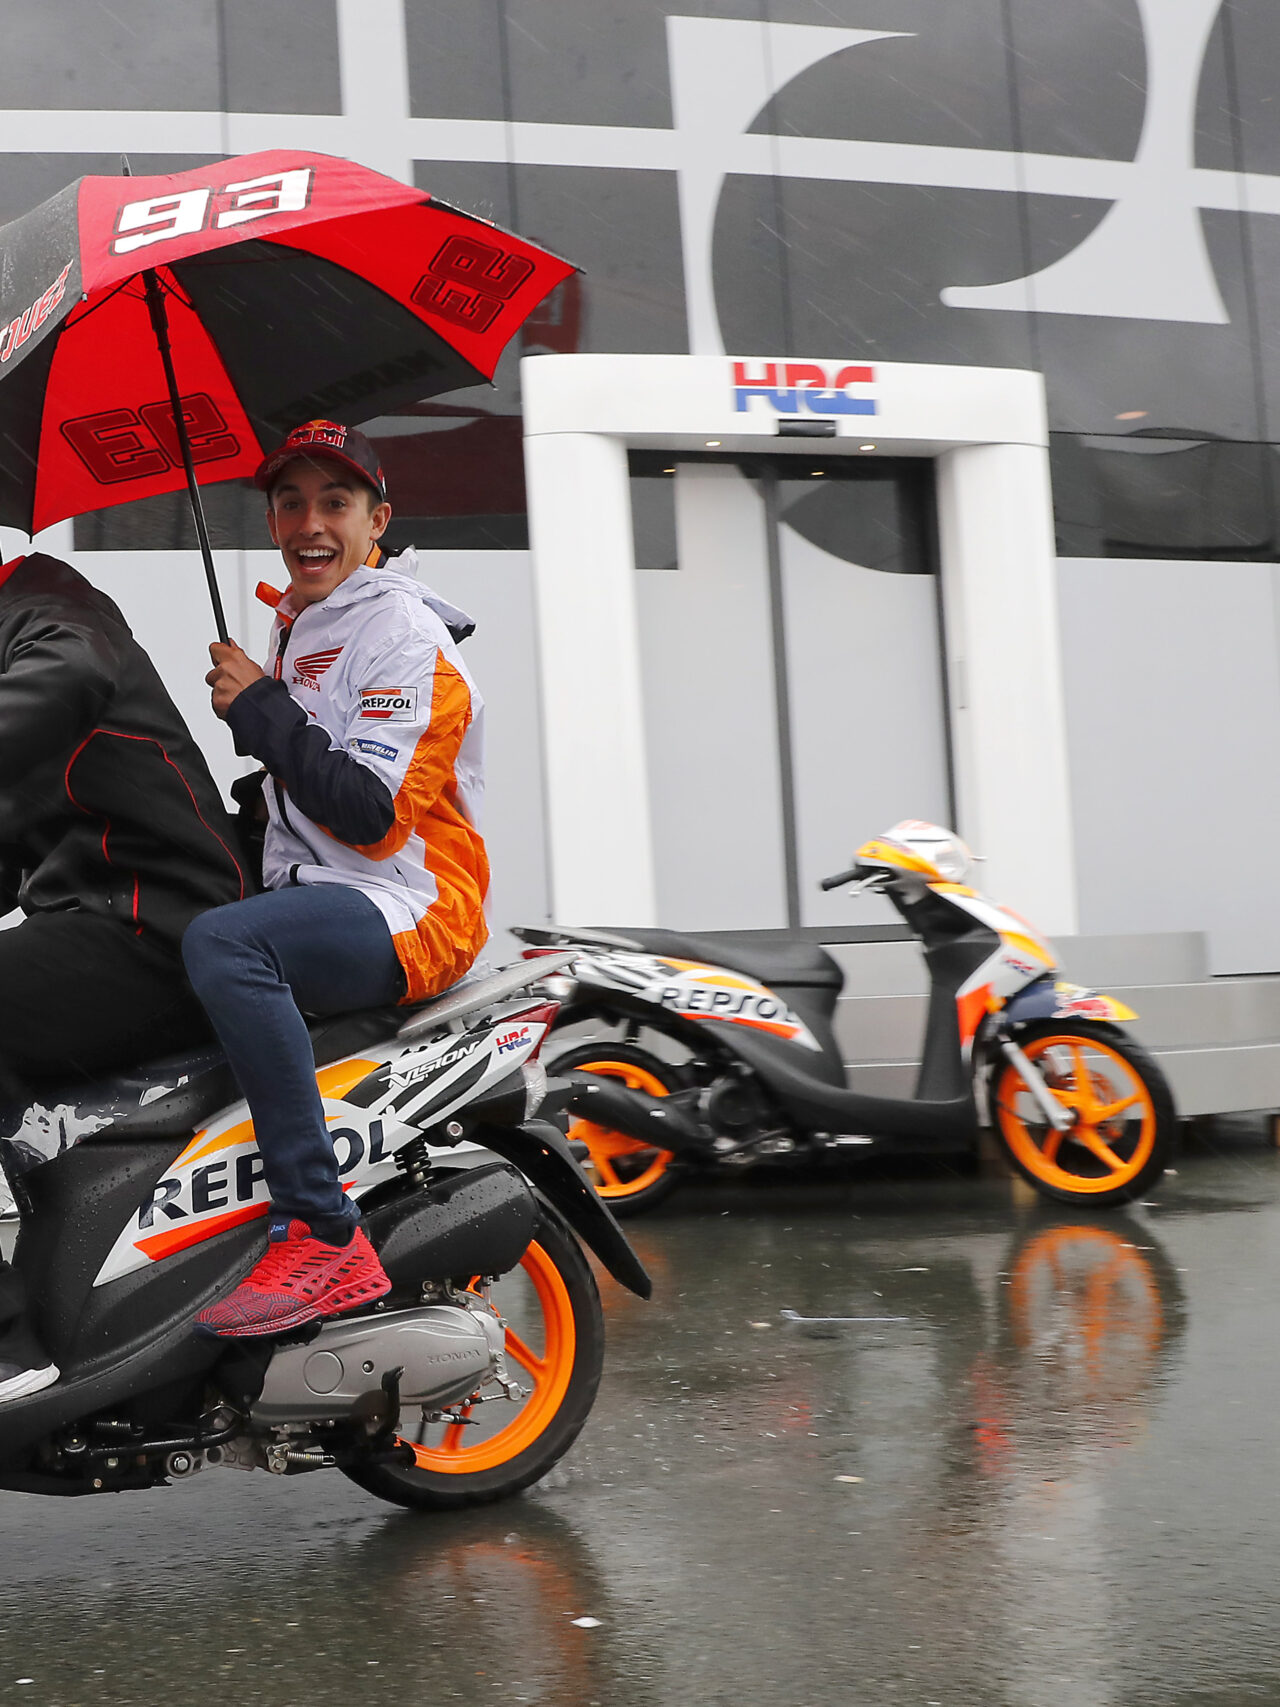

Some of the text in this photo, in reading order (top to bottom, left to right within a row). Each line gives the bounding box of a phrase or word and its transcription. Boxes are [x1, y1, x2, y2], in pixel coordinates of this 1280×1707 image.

[112, 167, 312, 255] 93
[732, 362, 877, 415] HRC
[314, 429, 345, 449] Bull
[361, 698, 412, 709] REPSOL
[378, 1040, 480, 1089] VISION
[138, 1119, 392, 1230] REPOL
